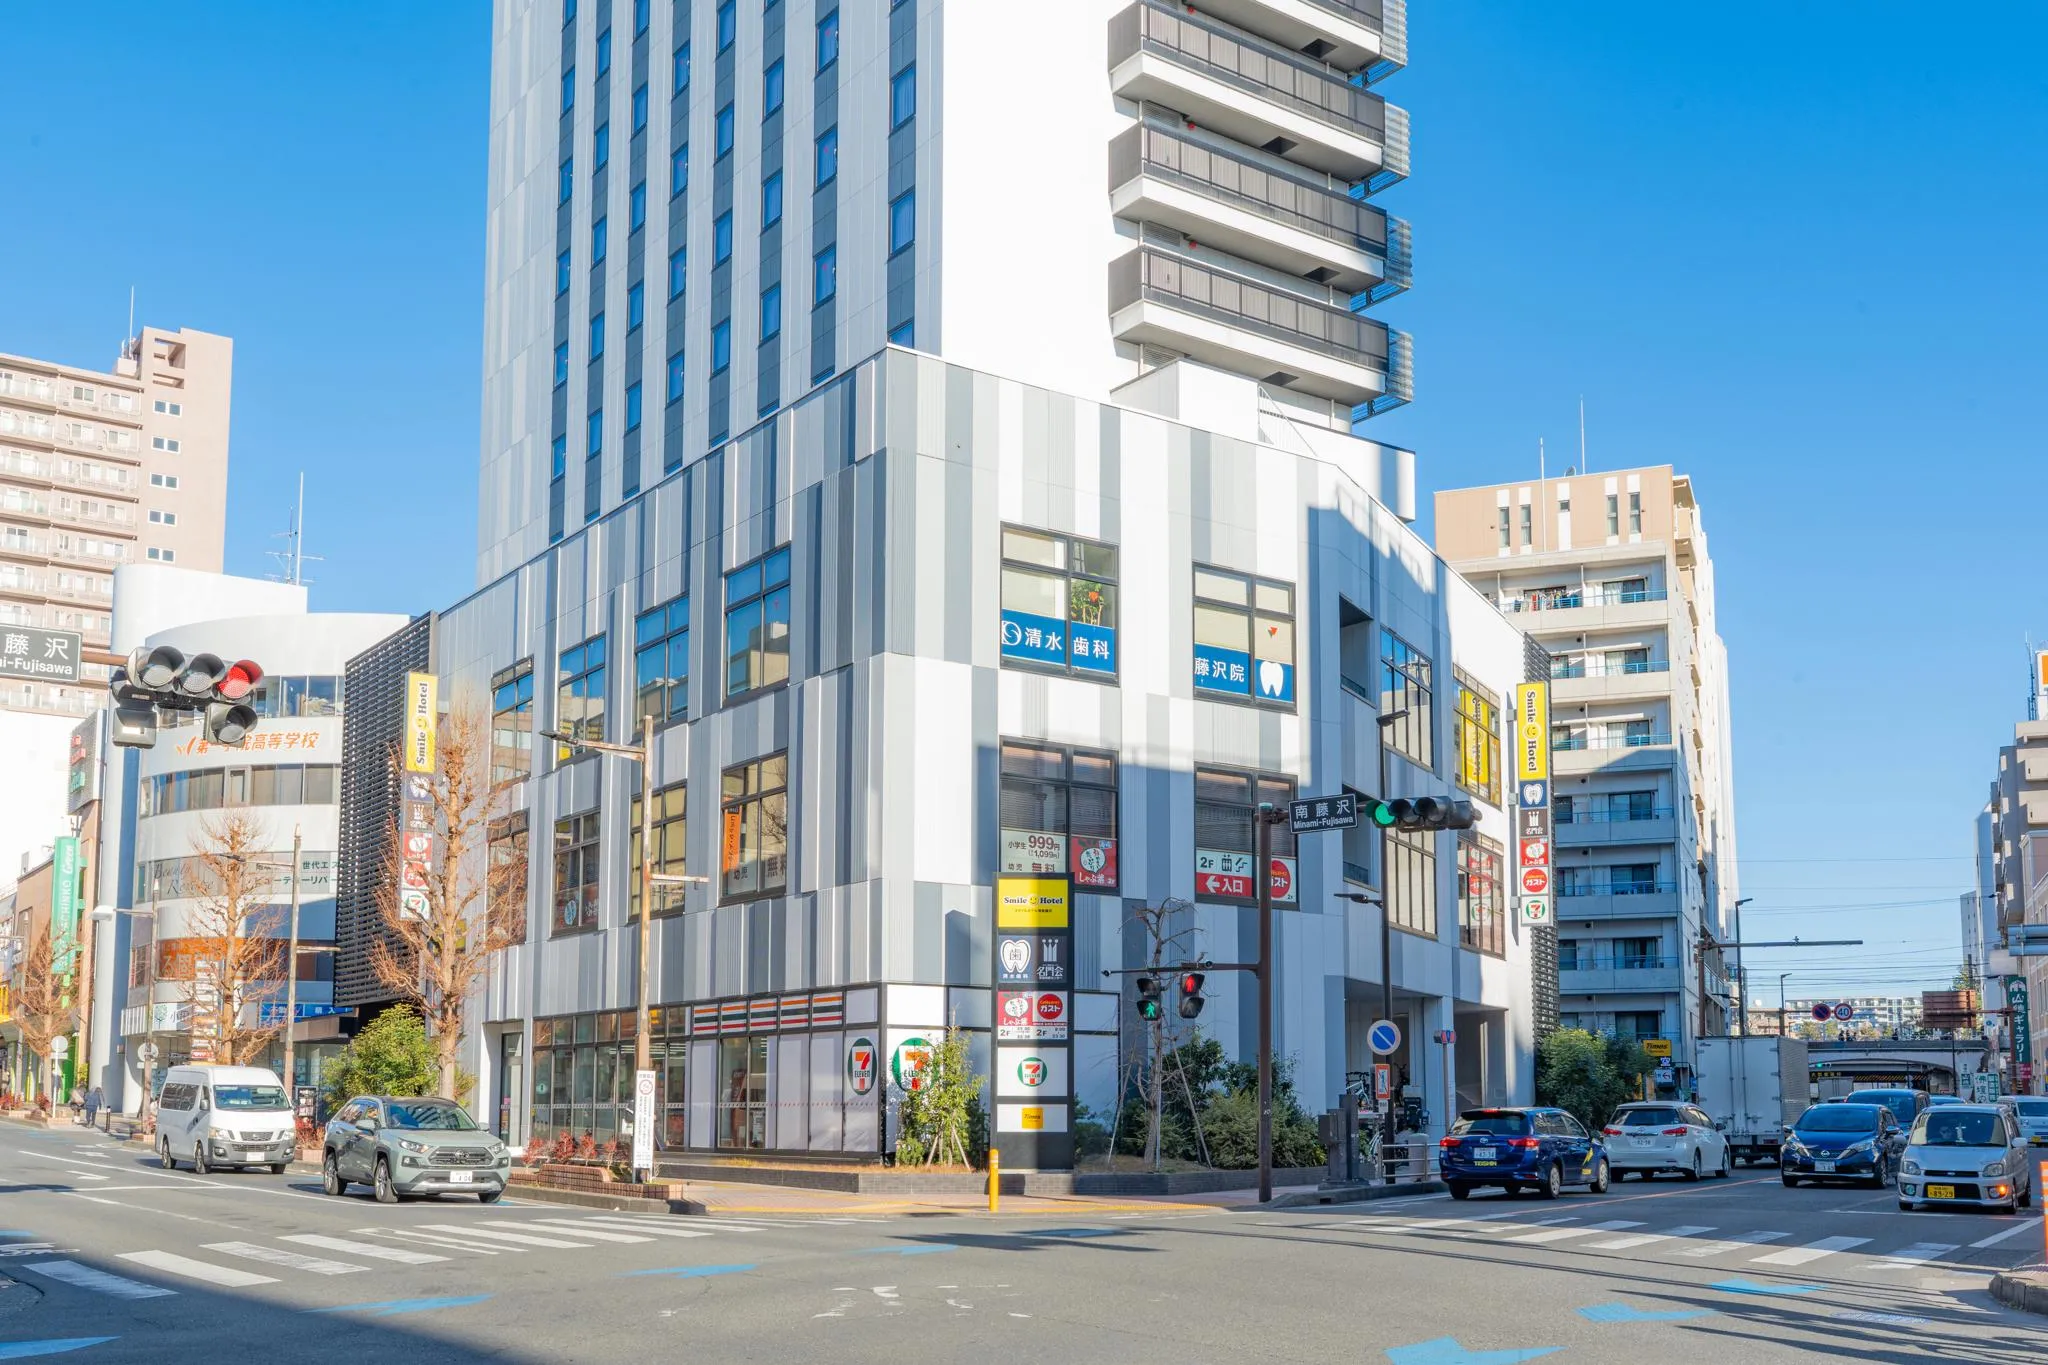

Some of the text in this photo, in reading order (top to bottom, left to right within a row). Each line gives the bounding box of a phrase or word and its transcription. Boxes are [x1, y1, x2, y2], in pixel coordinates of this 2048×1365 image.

[4, 633, 69, 660] 藤沢
[1025, 627, 1110, 660] 清水歯科
[1194, 656, 1246, 683] 藤沢院
[416, 682, 428, 765] Smile Hotel
[1527, 691, 1537, 772] Smile Hotel
[1294, 800, 1351, 820] 南藤沢
[1293, 815, 1354, 831] Minami-Fujisawa
[1200, 856, 1215, 869] 2F
[1222, 878, 1243, 894] 入口
[1036, 966, 1064, 977] 名門会
[1040, 1005, 1061, 1013] ガスト
[1837, 1007, 1850, 1017] 40
[1036, 1028, 1048, 1037] 2F
[855, 1070, 871, 1078] ELEVEN
